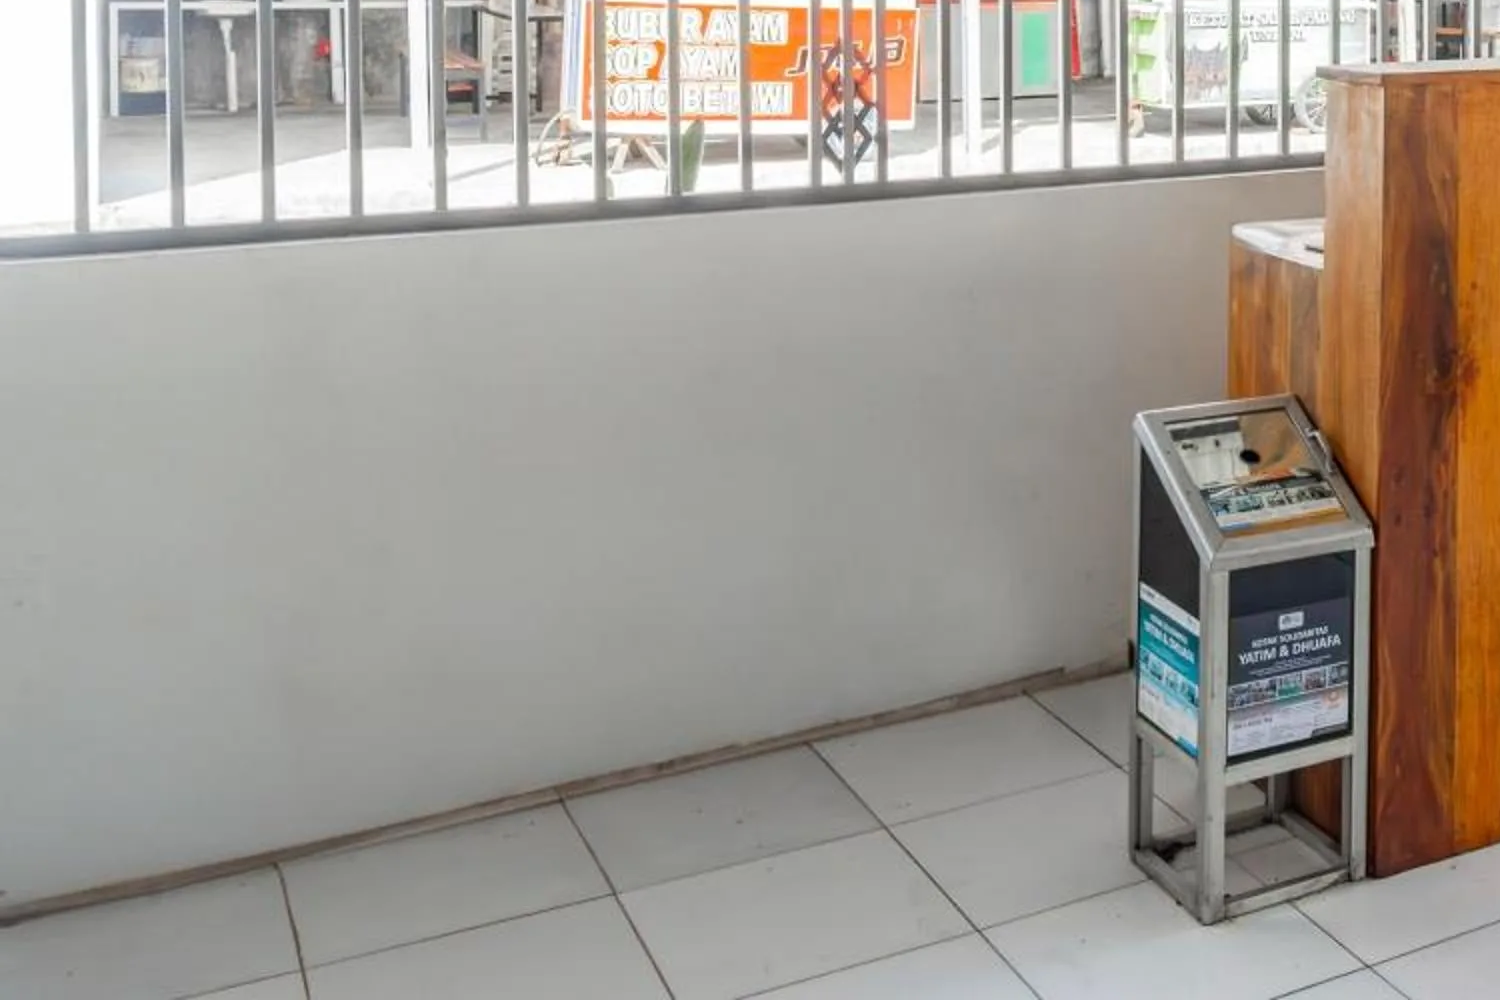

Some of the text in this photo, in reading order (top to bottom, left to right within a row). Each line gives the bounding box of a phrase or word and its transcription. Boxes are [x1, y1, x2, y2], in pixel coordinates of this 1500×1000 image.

[663, 46, 739, 79] YAM
[1238, 646, 1277, 665] YATIM
[1279, 645, 1291, 657] &
[1291, 634, 1342, 654] DHUAFA
